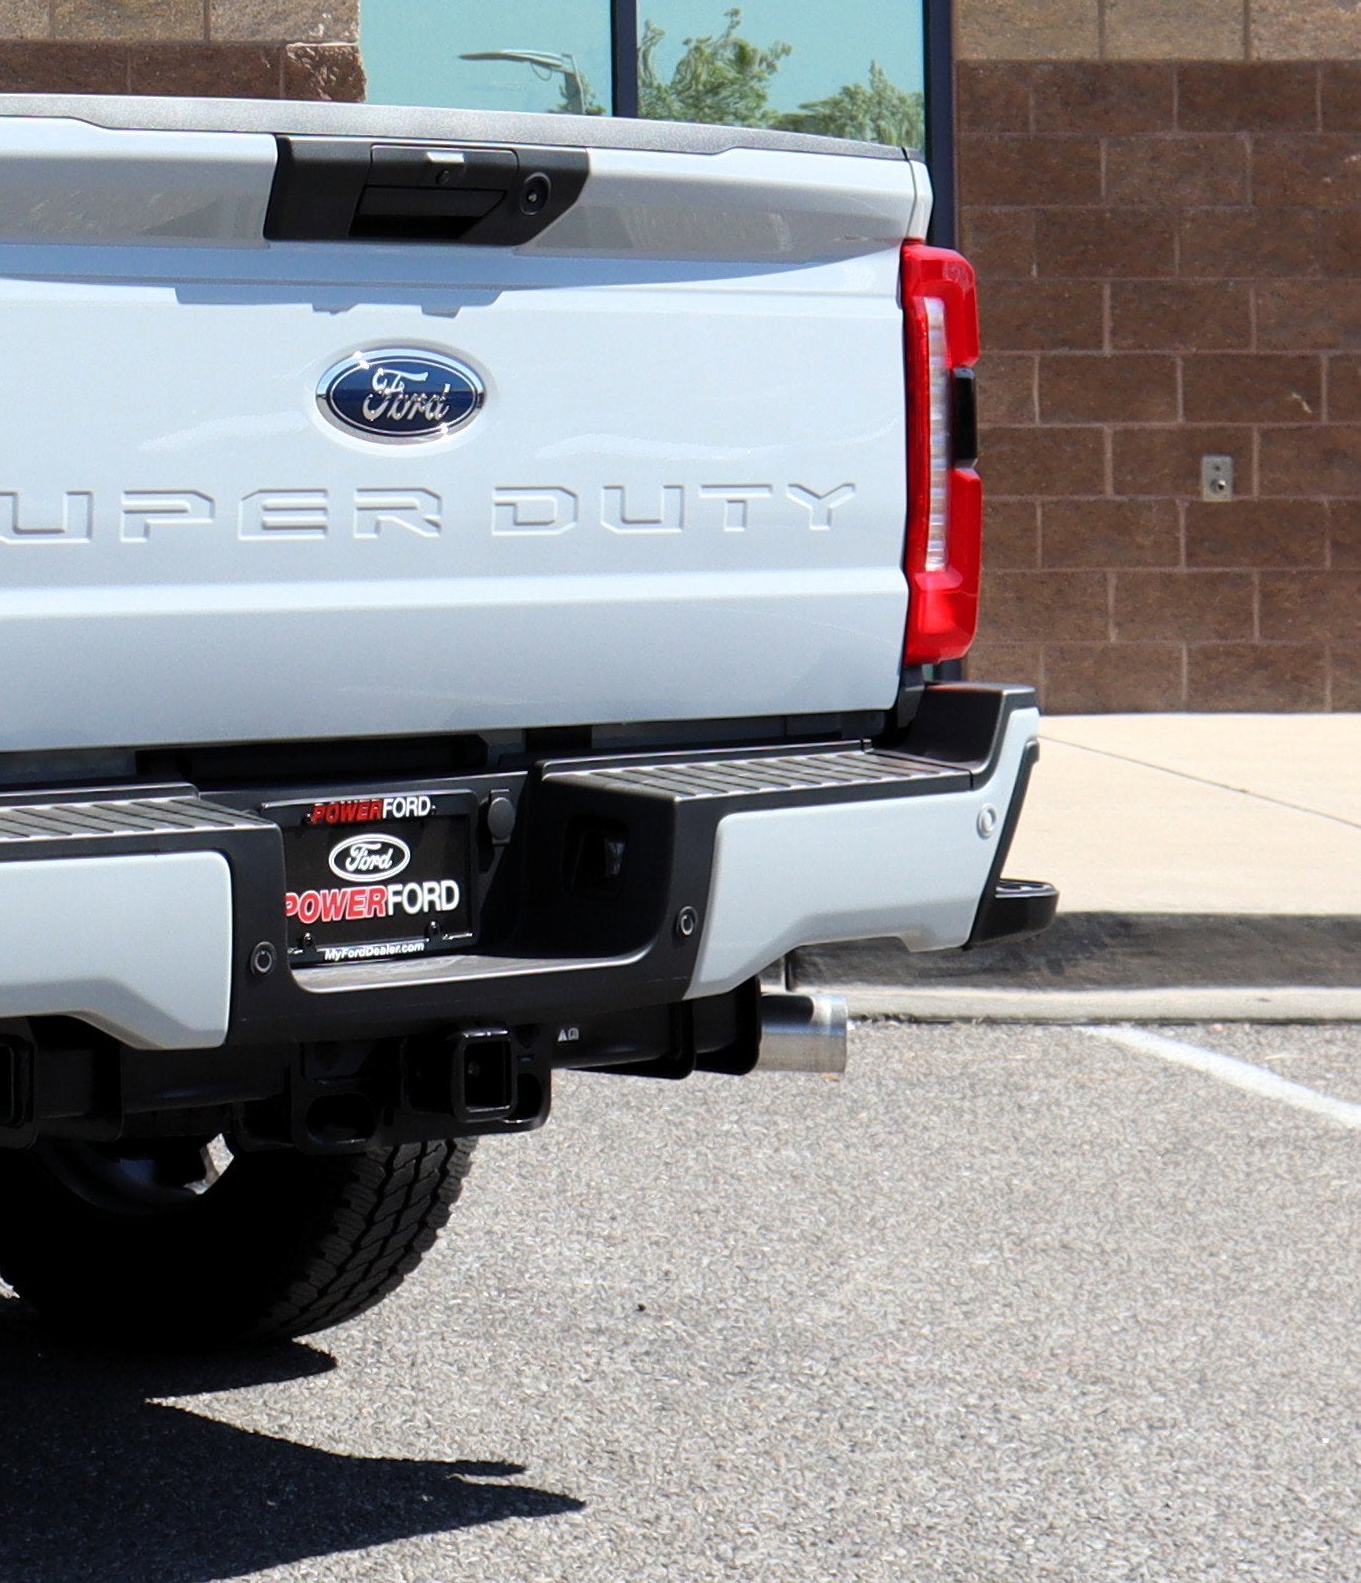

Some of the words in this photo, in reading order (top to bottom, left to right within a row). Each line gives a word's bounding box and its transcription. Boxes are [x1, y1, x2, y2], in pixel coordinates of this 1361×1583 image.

[362, 367, 451, 421] Ford
[491, 481, 858, 539] DUTY
[345, 843, 394, 871] Ford
[324, 942, 424, 961] MyFordDealer.com
